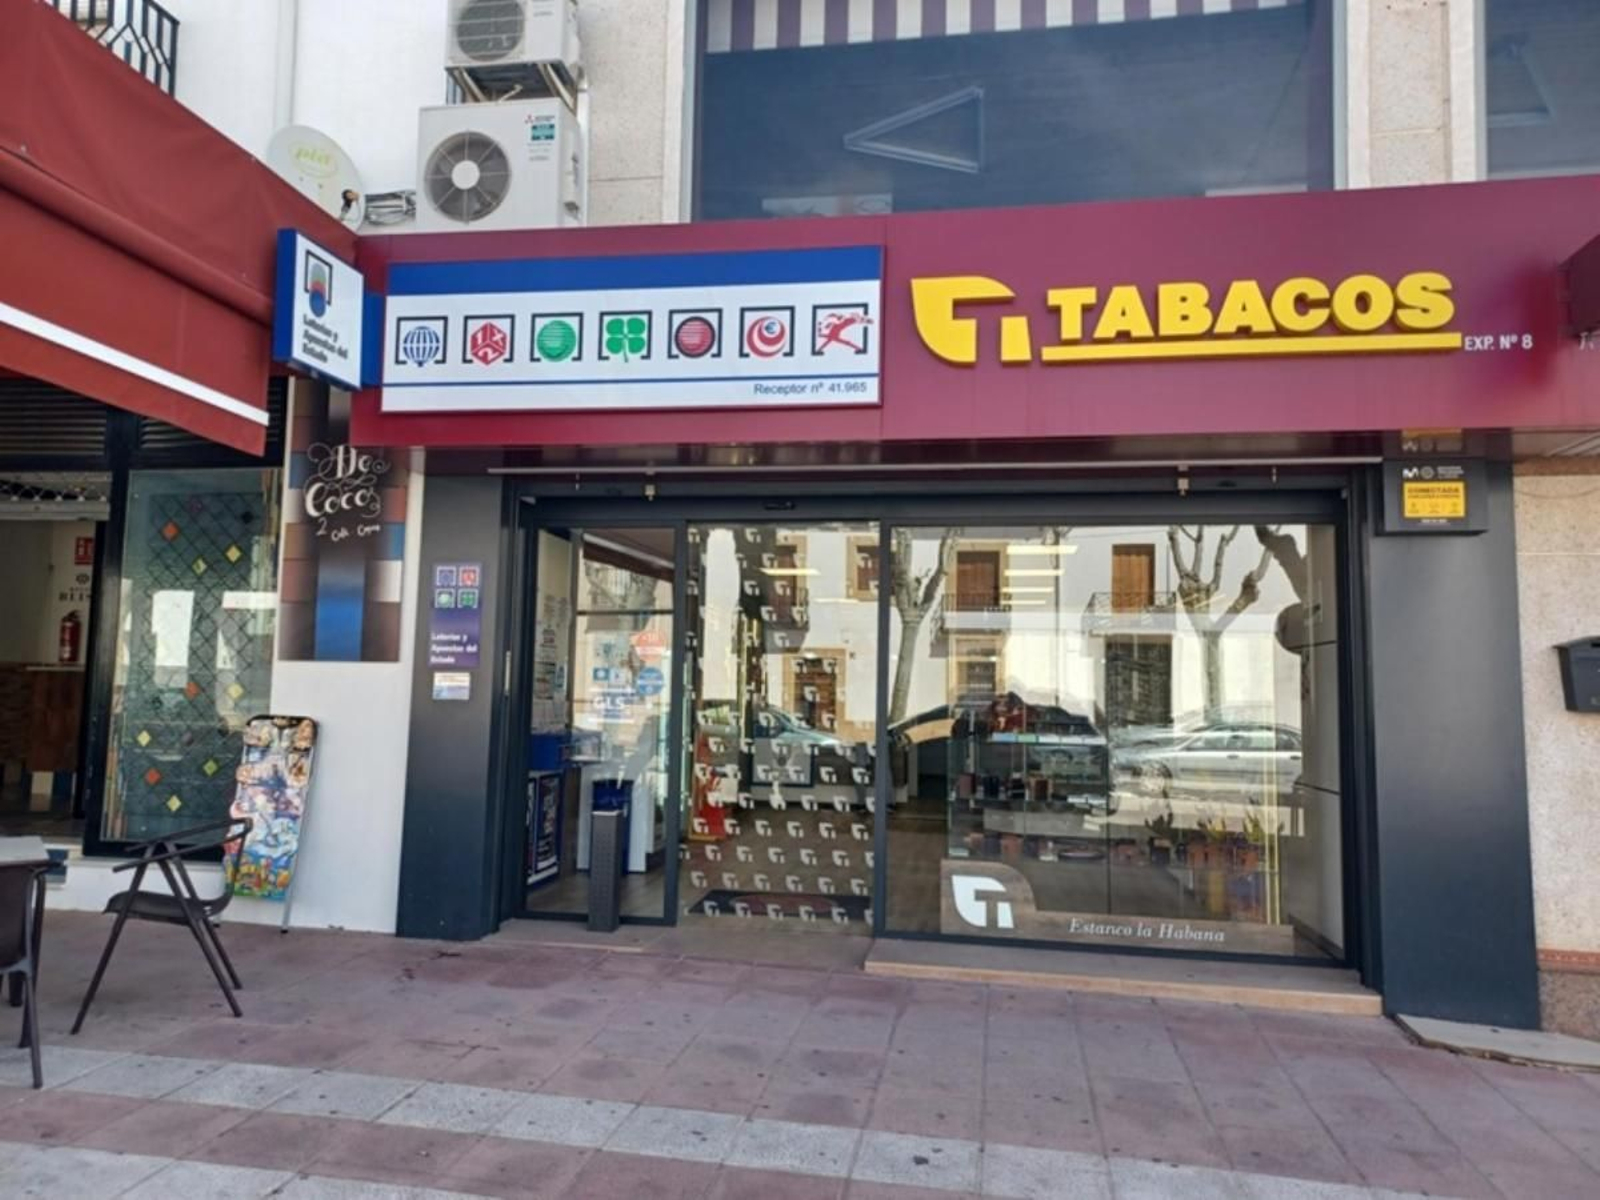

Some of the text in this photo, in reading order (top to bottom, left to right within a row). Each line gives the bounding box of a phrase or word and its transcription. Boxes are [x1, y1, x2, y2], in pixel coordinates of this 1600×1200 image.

[1046, 271, 1455, 342] TABACOS
[1464, 335, 1495, 351] EXP.
[1521, 333, 1534, 350] 8
[753, 383, 807, 397] Receptor
[828, 381, 868, 394] 41.965
[320, 444, 381, 480] De
[1068, 916, 1226, 943] Estanco la Habana
